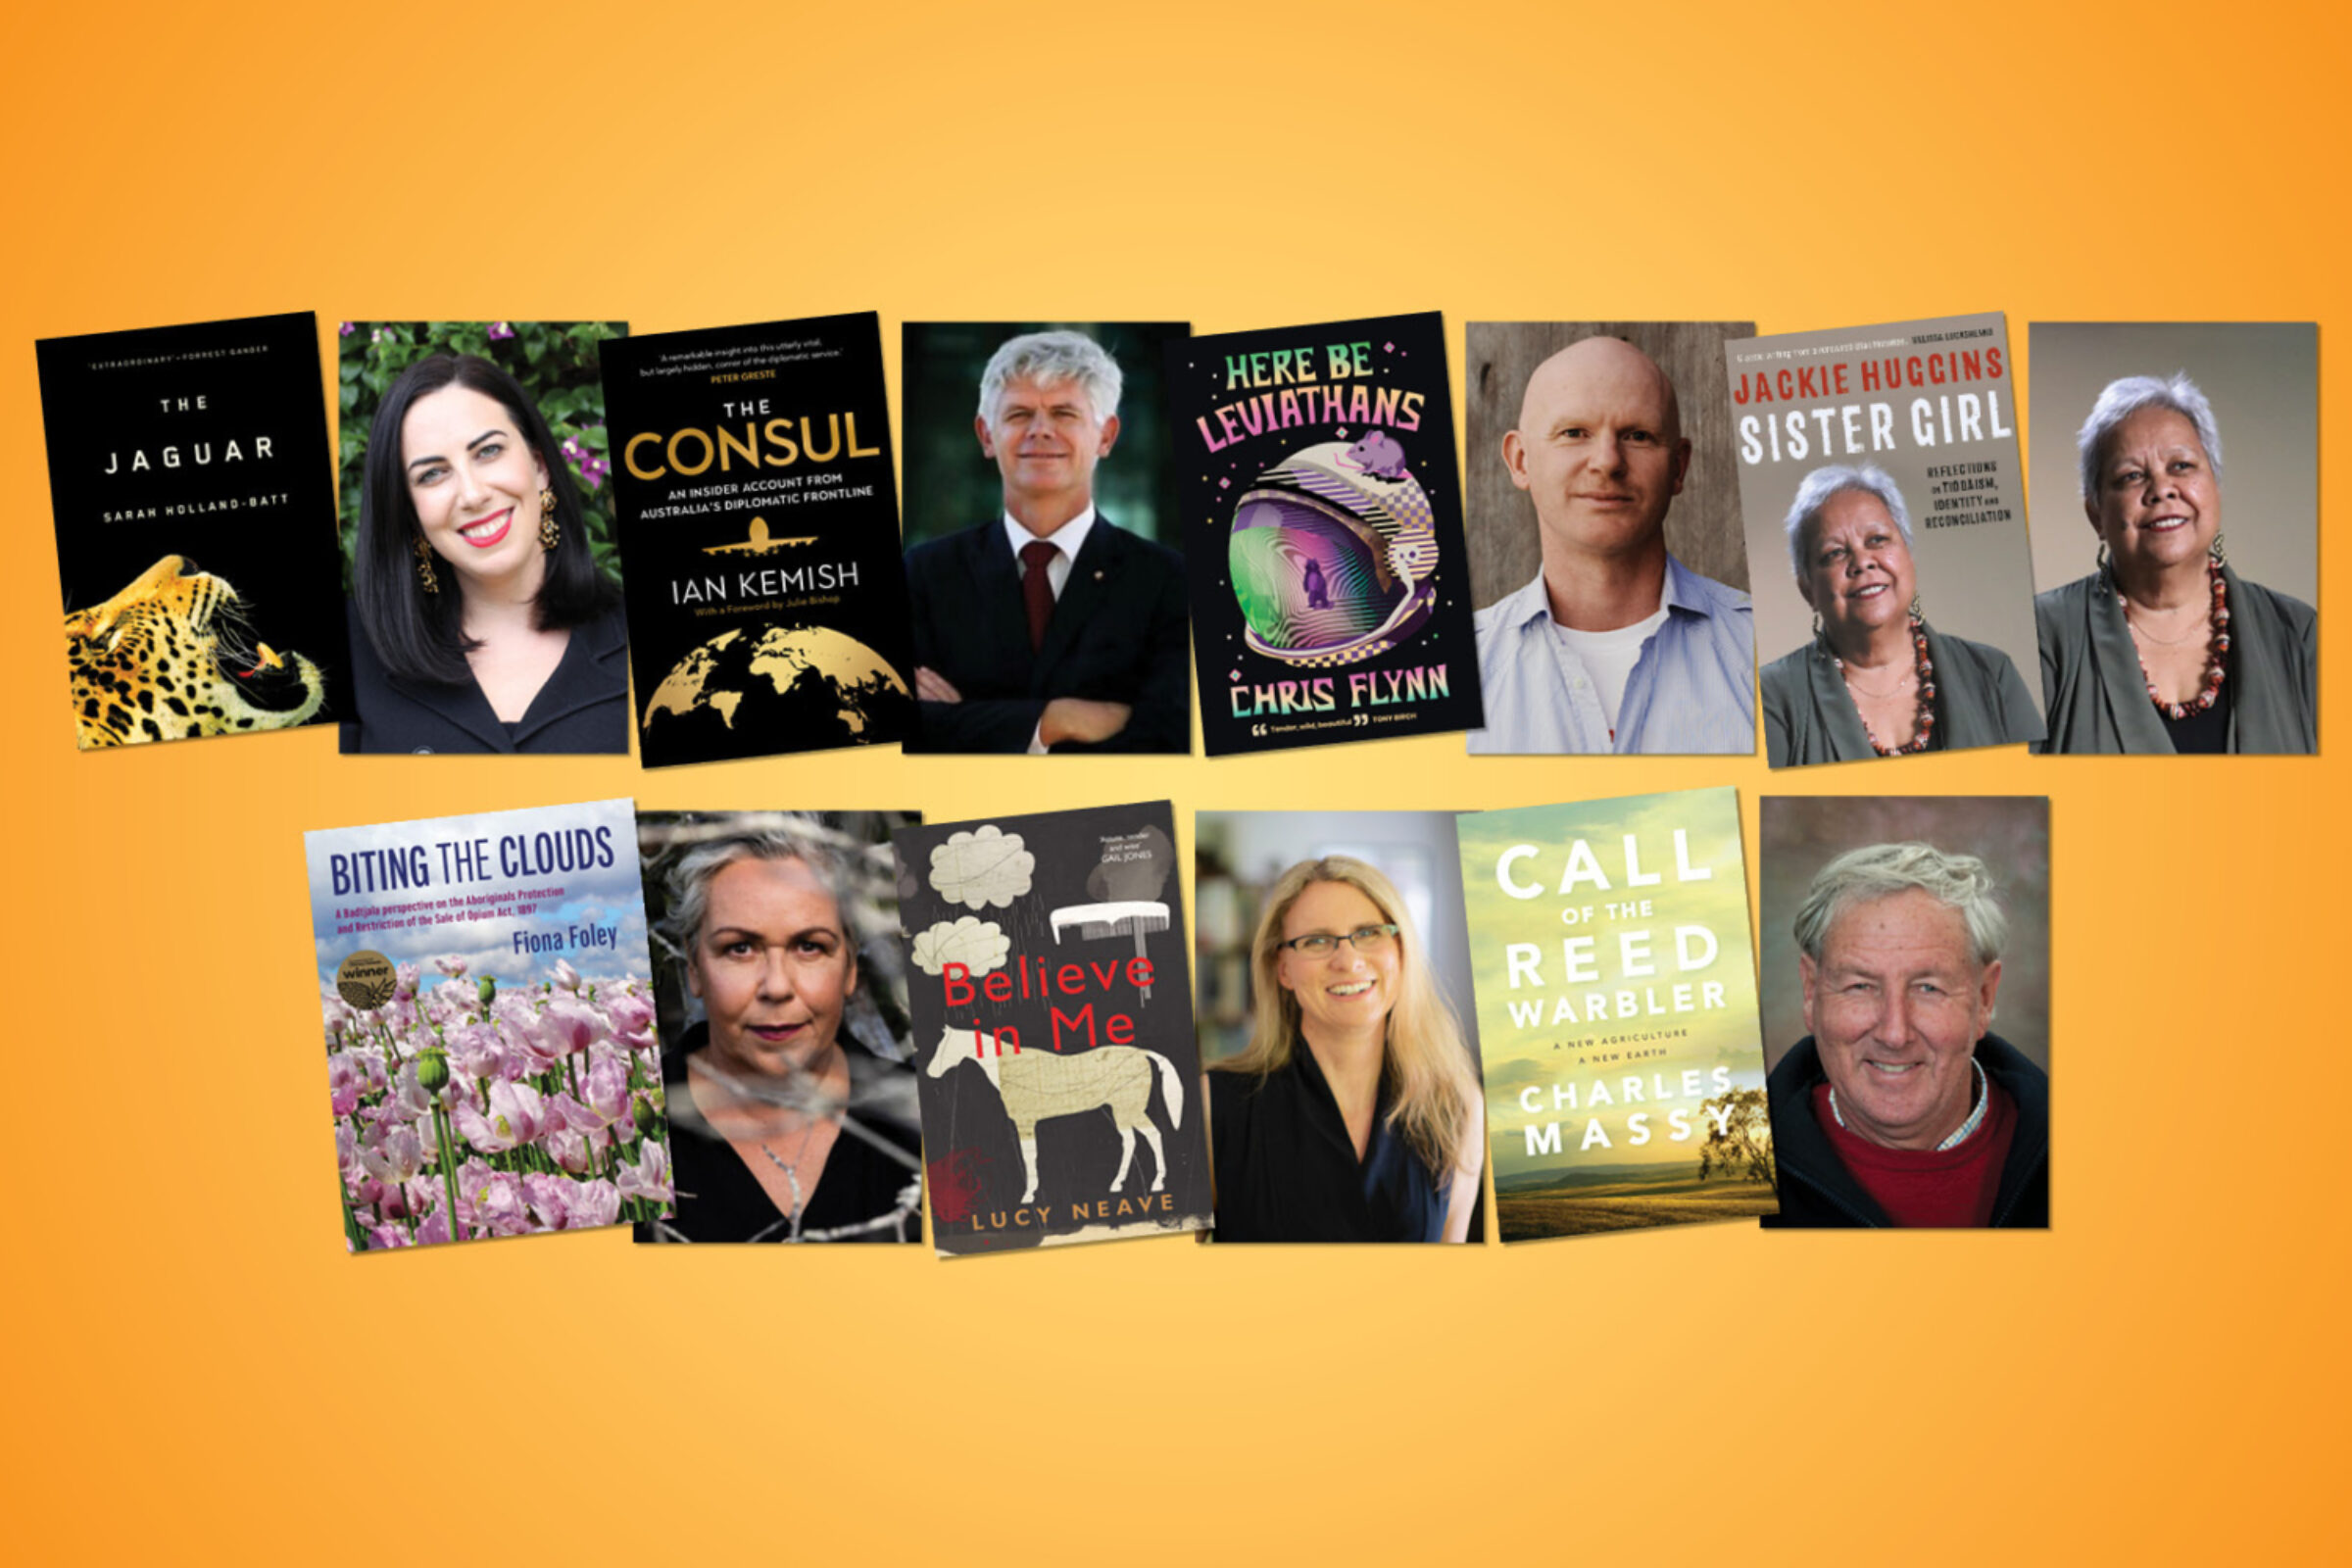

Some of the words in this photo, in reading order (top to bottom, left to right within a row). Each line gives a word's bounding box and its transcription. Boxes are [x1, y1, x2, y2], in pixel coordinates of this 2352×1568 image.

[710, 372, 739, 384] PETER
[1224, 347, 1317, 391] HERE
[1326, 341, 1373, 380] BE
[1734, 364, 1849, 405] JACKIE
[1861, 347, 2004, 392] HUGGINS
[161, 396, 208, 413] THE
[723, 399, 771, 417] THE
[1196, 384, 1425, 454] LEVIATHANS
[1740, 402, 1895, 466] SISTER
[1911, 390, 2012, 447] GIRL
[104, 436, 273, 474] JAGUAR
[624, 412, 880, 480] CONSUL
[1927, 461, 1997, 478] REFLECTIONS
[640, 500, 721, 519] AUSTRALIA'S
[724, 492, 801, 512] DIPLOMATIC
[804, 485, 874, 504] FRONTLINE
[667, 489, 687, 502] AN
[689, 483, 739, 499] INSIDER
[742, 476, 803, 494] ACCOUNT
[807, 473, 843, 487] FROM
[1934, 495, 1984, 512] IDENTITY
[103, 507, 157, 523] SARAH
[166, 493, 289, 516] HOLLAND-BATT
[1925, 509, 2012, 529] RECONCILIATION
[671, 575, 726, 605] IAN
[739, 562, 859, 598] KEMISH
[694, 607, 717, 617] With
[718, 607, 726, 615] a
[726, 599, 770, 613] Foreword
[771, 600, 784, 612] by
[786, 596, 808, 609] Julie
[808, 594, 841, 606] Bishop
[1230, 677, 1336, 718] CHRIS
[1348, 663, 1450, 708] FLYNN
[329, 845, 430, 896] BITING
[435, 838, 492, 884] THE
[500, 825, 614, 879] CLOUDS
[1102, 853, 1122, 863] GAIL
[1123, 850, 1152, 863] JONES
[1495, 828, 1712, 900] CALL
[335, 908, 342, 919] A
[382, 898, 434, 915] perspective
[436, 899, 448, 909] on
[449, 896, 464, 907] the
[466, 891, 516, 907] Aboriginals
[517, 886, 565, 902] Protection
[336, 922, 354, 935] and
[355, 917, 405, 932] Restriction
[406, 915, 416, 927] of
[417, 914, 432, 926] the
[434, 911, 454, 924] Sale
[456, 910, 466, 921] of
[466, 906, 495, 923] Opium
[496, 906, 515, 918] Act,
[517, 904, 538, 915] 1897
[1561, 906, 1594, 925] OF
[1605, 900, 1653, 920] THE
[513, 930, 564, 956] Fiona
[568, 922, 618, 952] Foley
[343, 966, 388, 979] winner
[1505, 924, 1719, 989] REED
[942, 955, 1155, 1007] Believe
[1507, 980, 1726, 1029] WARBLER
[973, 1018, 1021, 1058] in
[1050, 1003, 1136, 1052] Me
[1553, 1042, 1561, 1051] A
[1568, 1038, 1595, 1050] NEW
[1601, 1029, 1689, 1046] AGRICULTURE
[1579, 1055, 1587, 1065] A
[1592, 1054, 1619, 1063] NEW
[1627, 1049, 1667, 1060] EARTH
[1519, 1065, 1733, 1113] CHARLES
[1524, 1103, 1735, 1157] MASSY
[971, 1206, 1052, 1231] LUCY
[1072, 1193, 1174, 1221] NEAVE
